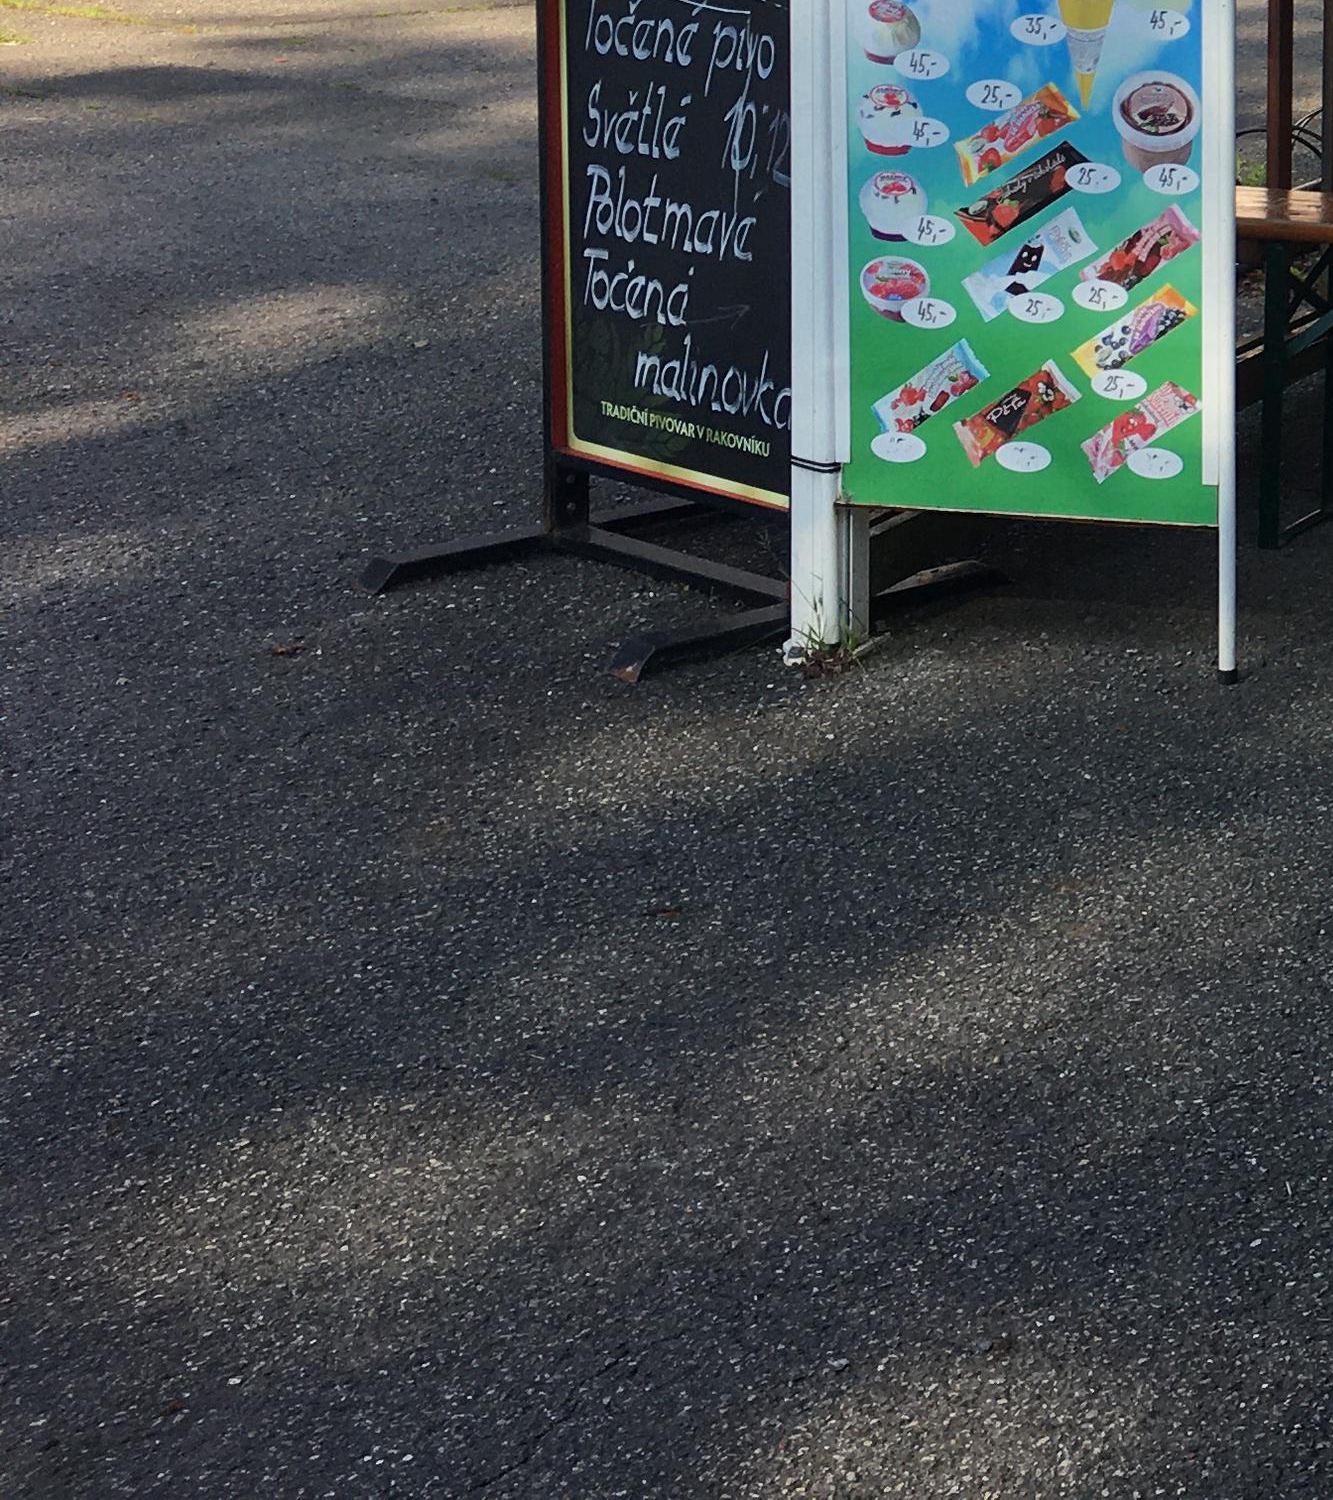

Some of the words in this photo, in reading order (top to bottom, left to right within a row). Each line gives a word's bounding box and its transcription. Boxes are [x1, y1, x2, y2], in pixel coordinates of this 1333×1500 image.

[1024, 16, 1057, 40] 35,-
[1149, 10, 1182, 35] 45,-
[704, 18, 775, 98] pivo
[909, 52, 937, 77] 45,-
[981, 84, 1013, 109] 25,-
[583, 79, 693, 160] Světlé
[912, 120, 941, 146] 45,-
[1158, 167, 1188, 191] 45,-
[917, 217, 947, 243] 45,-
[1088, 286, 1119, 310] 25,-
[917, 300, 947, 324] 45,-
[1103, 375, 1136, 399] 25,-
[600, 400, 649, 427] TRADIČNÍ
[649, 413, 696, 439] PIVOVAR
[697, 425, 706, 438] V
[706, 427, 771, 458] RAKOVNÍKU
